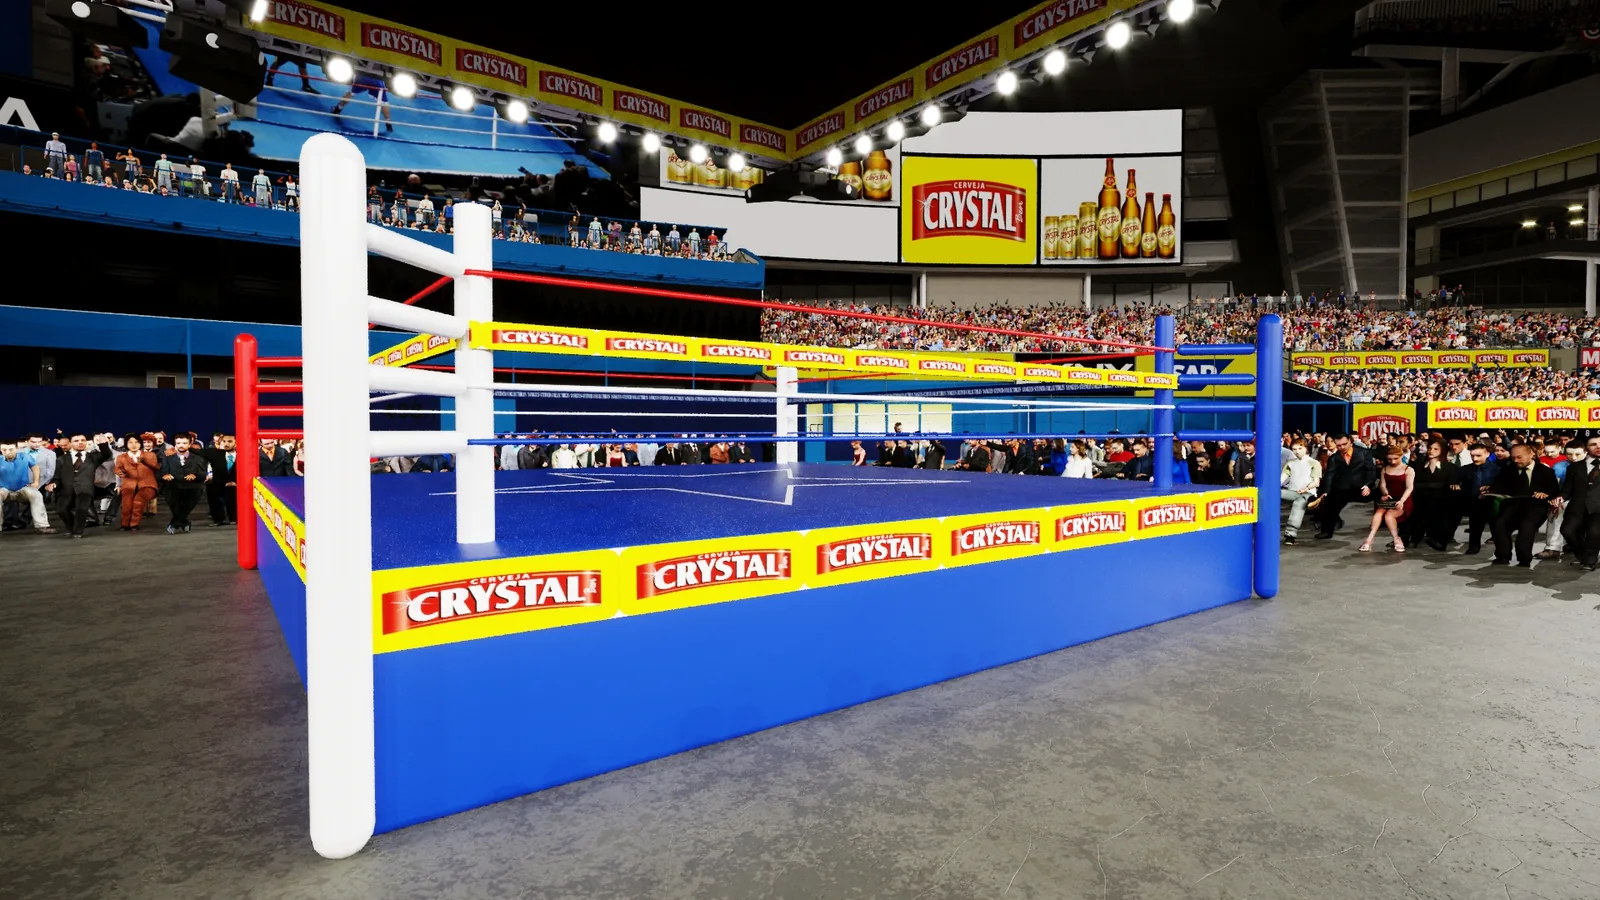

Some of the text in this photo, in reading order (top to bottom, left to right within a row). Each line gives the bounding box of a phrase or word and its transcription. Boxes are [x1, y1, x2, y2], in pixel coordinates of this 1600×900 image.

[265, 1, 338, 35] CRYSTAL
[369, 28, 435, 60] CRYSTAL
[463, 53, 521, 82] CRYSTAL
[932, 41, 993, 83] CRYSTAL
[546, 76, 597, 102] CRYSTAL
[619, 95, 666, 120] CRYSTAL
[860, 82, 909, 117] CRYSTAL
[685, 112, 727, 135] CRYSTAL
[801, 116, 840, 145] CRYSTAL
[744, 128, 781, 148] CRYSTAL
[923, 190, 1016, 232] CRYSTAL
[502, 330, 580, 347] CRYSTAL
[613, 338, 680, 354] CRYSTAL
[708, 346, 765, 360] CRYSTAL
[790, 351, 840, 363] CRYSTAL
[1298, 357, 1323, 365] CRYSTAL
[1332, 356, 1358, 364] CRYSTAL
[1368, 356, 1395, 364] CRYSTAL
[1404, 356, 1431, 364] CRYSTAL
[1441, 355, 1468, 363] CRYSTAL
[861, 356, 906, 368] CRYSTAL
[923, 361, 961, 371] CRYSTAL
[979, 365, 1014, 375] CRYSTAL
[1027, 368, 1059, 378] CRYSTAL
[1070, 371, 1101, 380] CRYSTAL
[1111, 374, 1137, 383] CRYSTAL
[1439, 408, 1475, 420] CRYSTAL
[1490, 408, 1525, 420] CRYSTAL
[1541, 408, 1578, 420] CRYSTAL
[1143, 506, 1192, 526] CRYSTAL
[1211, 499, 1250, 518] CRYSTAL
[1063, 514, 1120, 537] CRYSTAL
[861, 534, 894, 542] CERVEJA
[960, 524, 1033, 550] CRYSTAL
[697, 550, 741, 560] CERVEJA
[829, 537, 923, 567] CRYSTAL
[470, 573, 530, 585] CERVEJA
[653, 554, 780, 590] CRYSTAL
[407, 576, 586, 622] CRYSTAL
